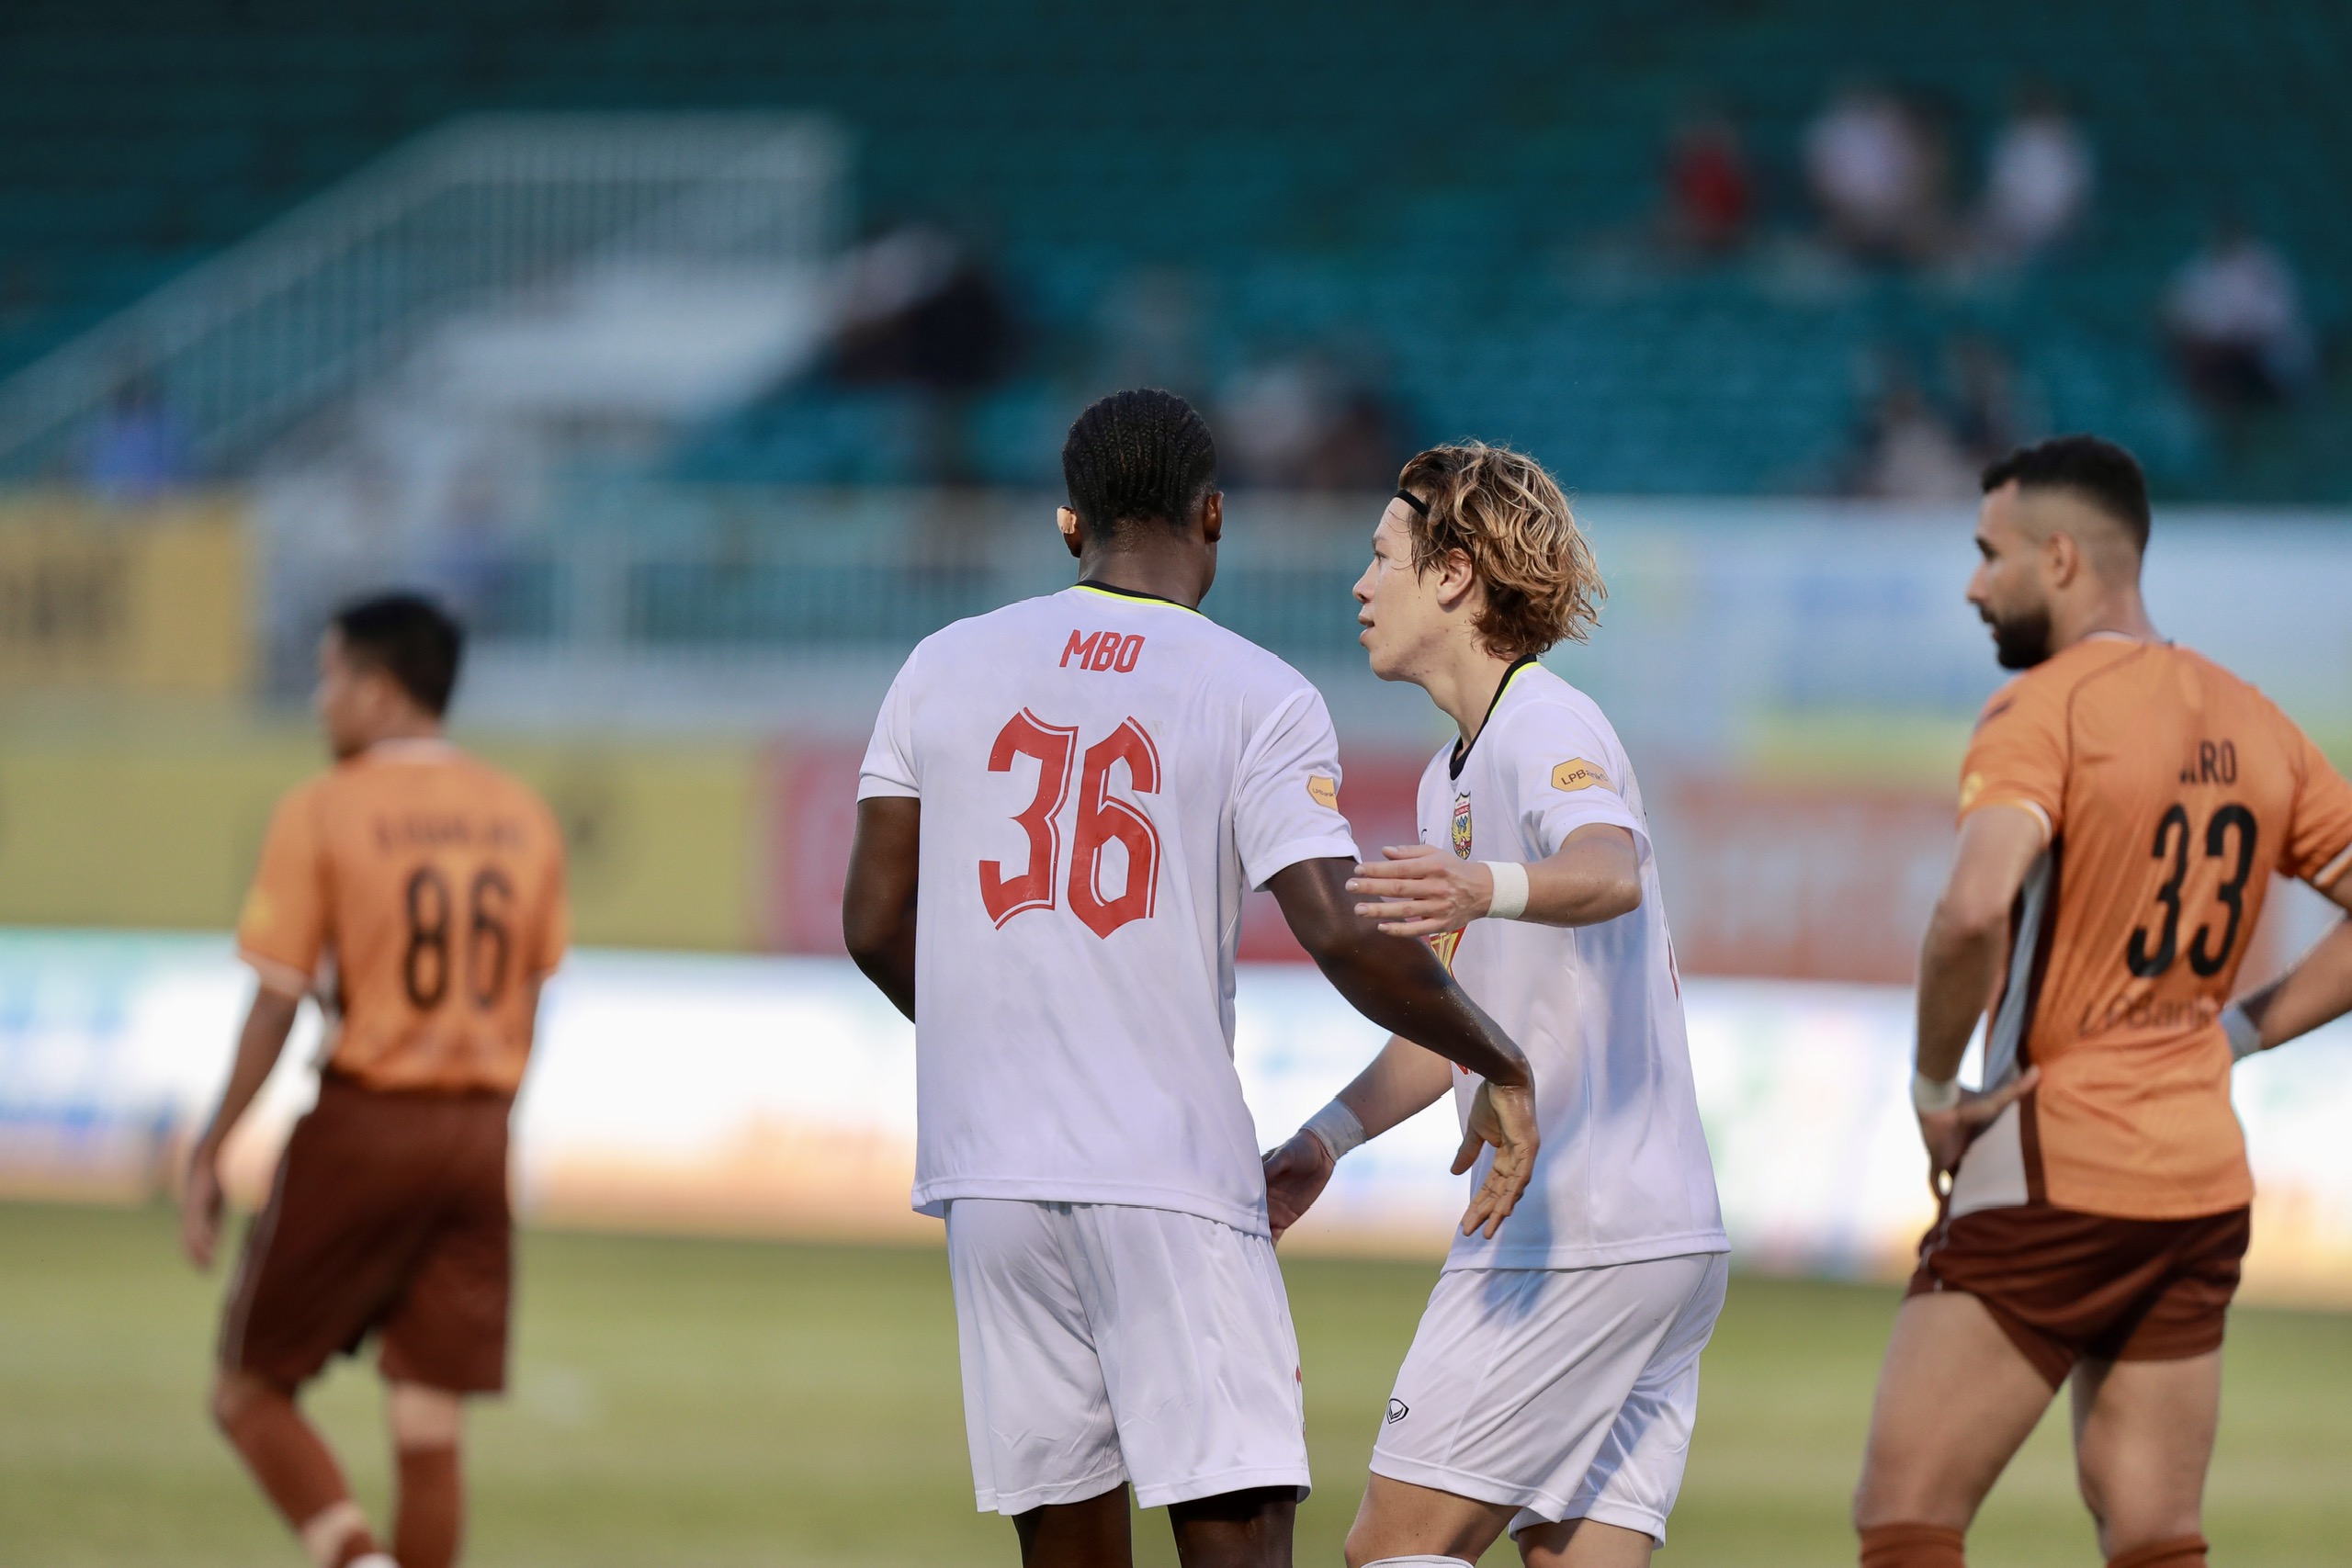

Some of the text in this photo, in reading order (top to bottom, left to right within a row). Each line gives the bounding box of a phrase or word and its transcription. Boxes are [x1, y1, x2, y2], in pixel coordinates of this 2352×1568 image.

[1059, 629, 1146, 673] MBO
[978, 706, 1161, 940] 36
[2126, 803, 2257, 977] 33
[404, 866, 512, 1011] 86
